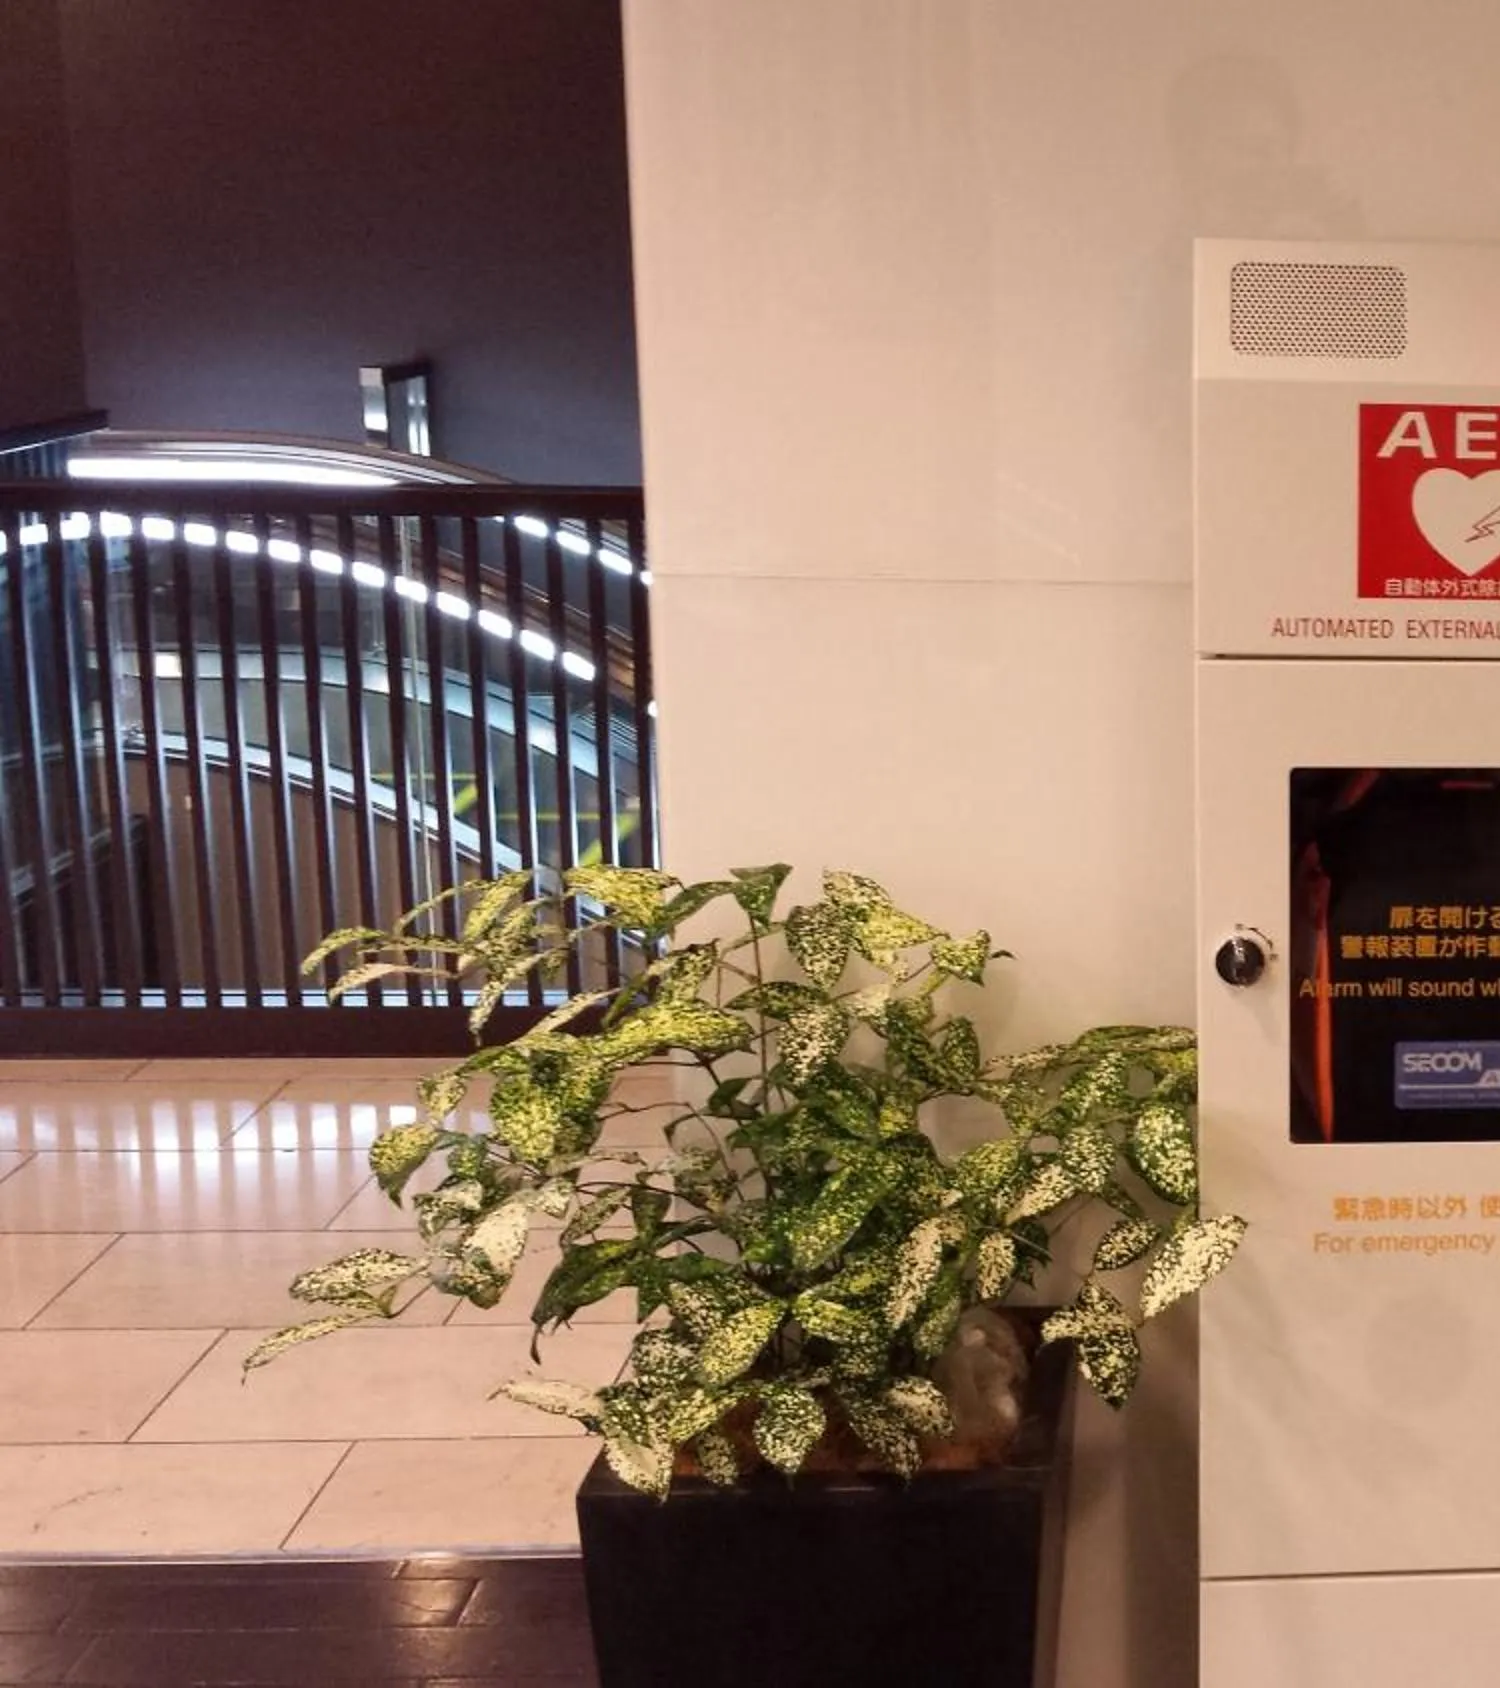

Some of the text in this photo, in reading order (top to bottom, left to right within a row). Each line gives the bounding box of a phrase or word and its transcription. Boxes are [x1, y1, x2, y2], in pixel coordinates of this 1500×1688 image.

[1271, 617, 1393, 639] AUTOMATED
[1299, 978, 1362, 998] Alarm
[1369, 978, 1402, 997] will
[1409, 979, 1473, 997] sound
[1403, 1051, 1482, 1073] SECOM
[1333, 1196, 1467, 1221] 緊急時以外
[1313, 1232, 1354, 1254] For
[1361, 1232, 1496, 1256] emergency
